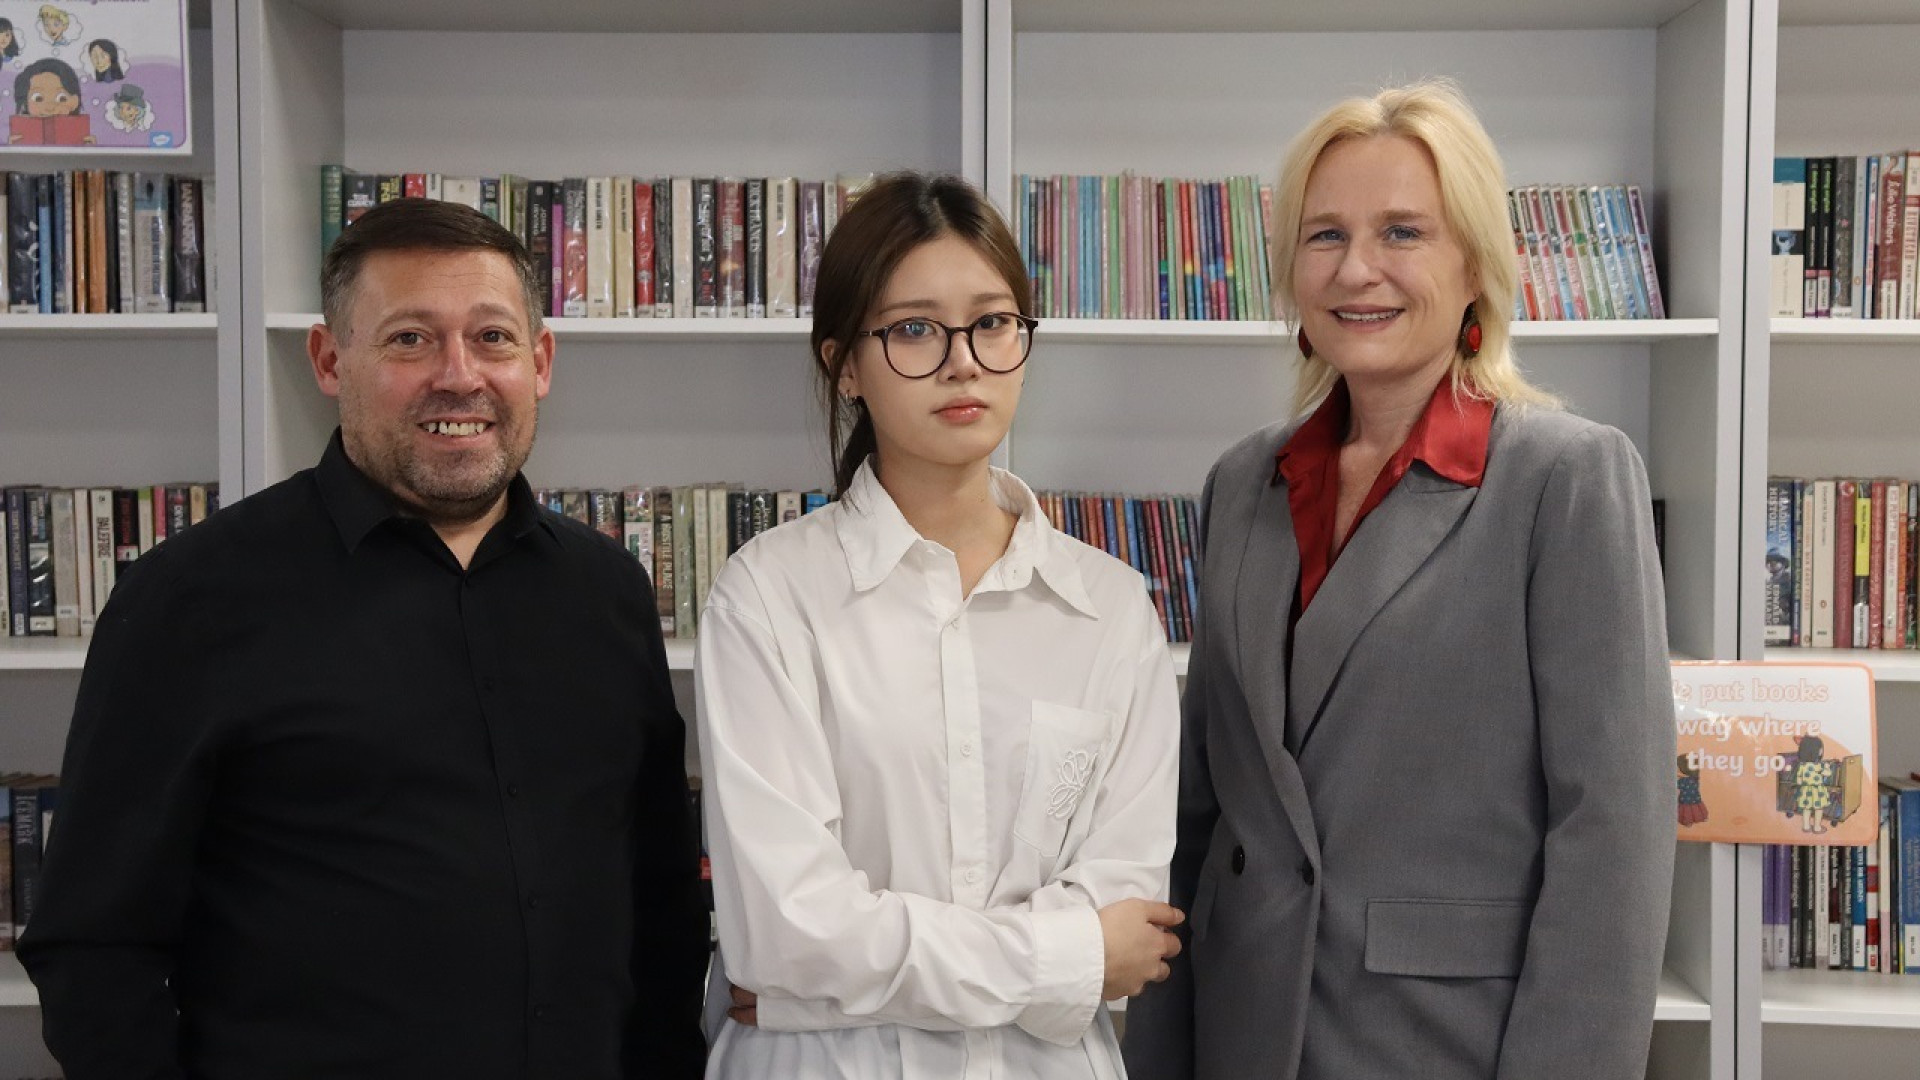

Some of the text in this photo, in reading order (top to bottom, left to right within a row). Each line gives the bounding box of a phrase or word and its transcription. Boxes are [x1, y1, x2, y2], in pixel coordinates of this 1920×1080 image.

[1885, 204, 1897, 246] Walters
[1700, 680, 1745, 708] put
[1751, 678, 1830, 703] books
[1738, 713, 1822, 737] where
[1686, 748, 1793, 778] they go.
